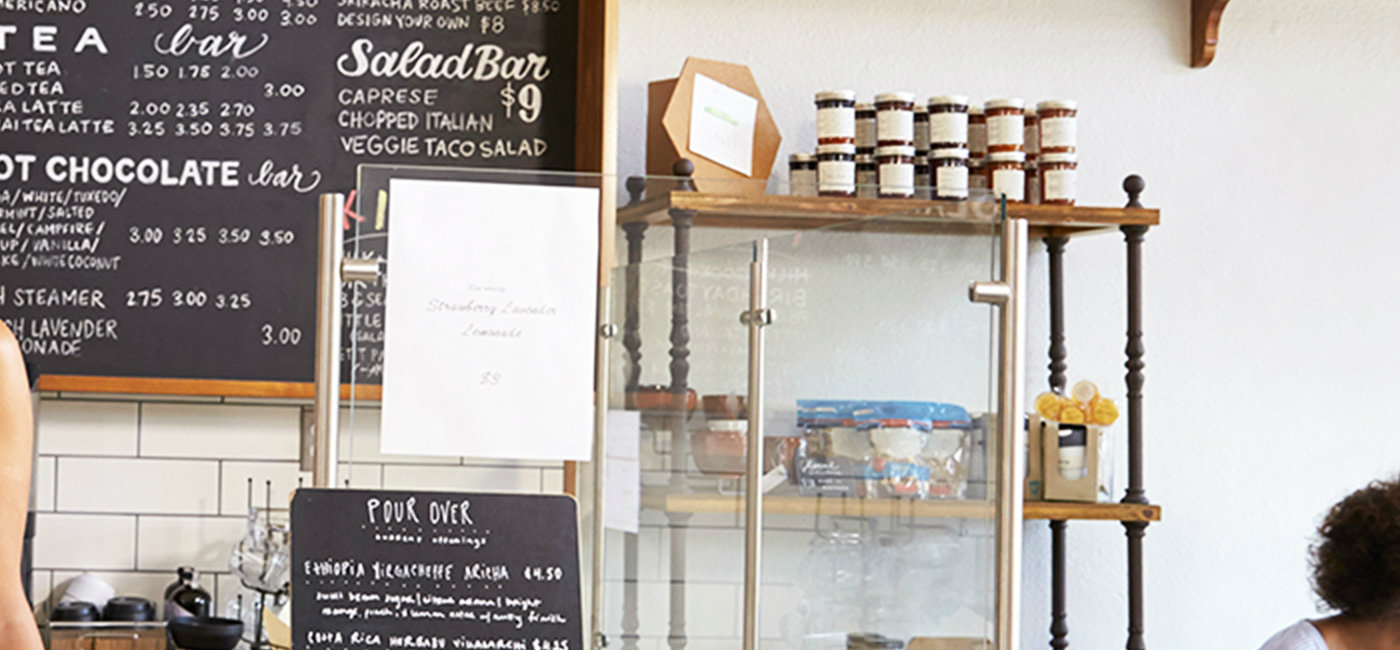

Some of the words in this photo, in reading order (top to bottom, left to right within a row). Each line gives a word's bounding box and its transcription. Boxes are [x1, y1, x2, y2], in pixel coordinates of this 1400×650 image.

[418, 0, 469, 13] ROAST
[337, 12, 393, 27] DESIGN
[394, 14, 433, 29] YOUR
[436, 15, 470, 30] OWN
[480, 14, 505, 35] $8
[154, 23, 269, 59] bar
[23, 60, 61, 76] TEA
[27, 80, 64, 96] TEA
[264, 82, 306, 98] 3.00
[338, 87, 438, 106] CAPRESE
[21, 99, 83, 115] LATTE
[129, 100, 171, 116] 2.00
[175, 101, 210, 118] 2.35
[220, 102, 255, 117] 2.70
[500, 81, 542, 123] $9
[21, 118, 55, 134] TEA
[58, 119, 115, 134] LATTE
[127, 121, 166, 137] 3.25
[175, 121, 214, 137] 3.50
[219, 122, 255, 138] 3.75
[263, 121, 302, 137] 3.75
[337, 108, 420, 131] CHOPPED
[425, 111, 493, 133] ITALIAN
[340, 134, 420, 156] VEGGIE
[424, 137, 476, 158] TACO
[479, 138, 546, 159] SALAD
[45, 155, 240, 187] CHOCOLATE
[247, 159, 322, 193] bar
[129, 226, 163, 244] 3.00
[258, 229, 295, 246] 3.50
[13, 288, 106, 309] STEAMER
[29, 318, 118, 342] LAVENDER
[261, 323, 302, 346] 3.00
[19, 336, 82, 358] ONADE
[366, 496, 420, 524] POUR
[429, 499, 474, 525] OVER
